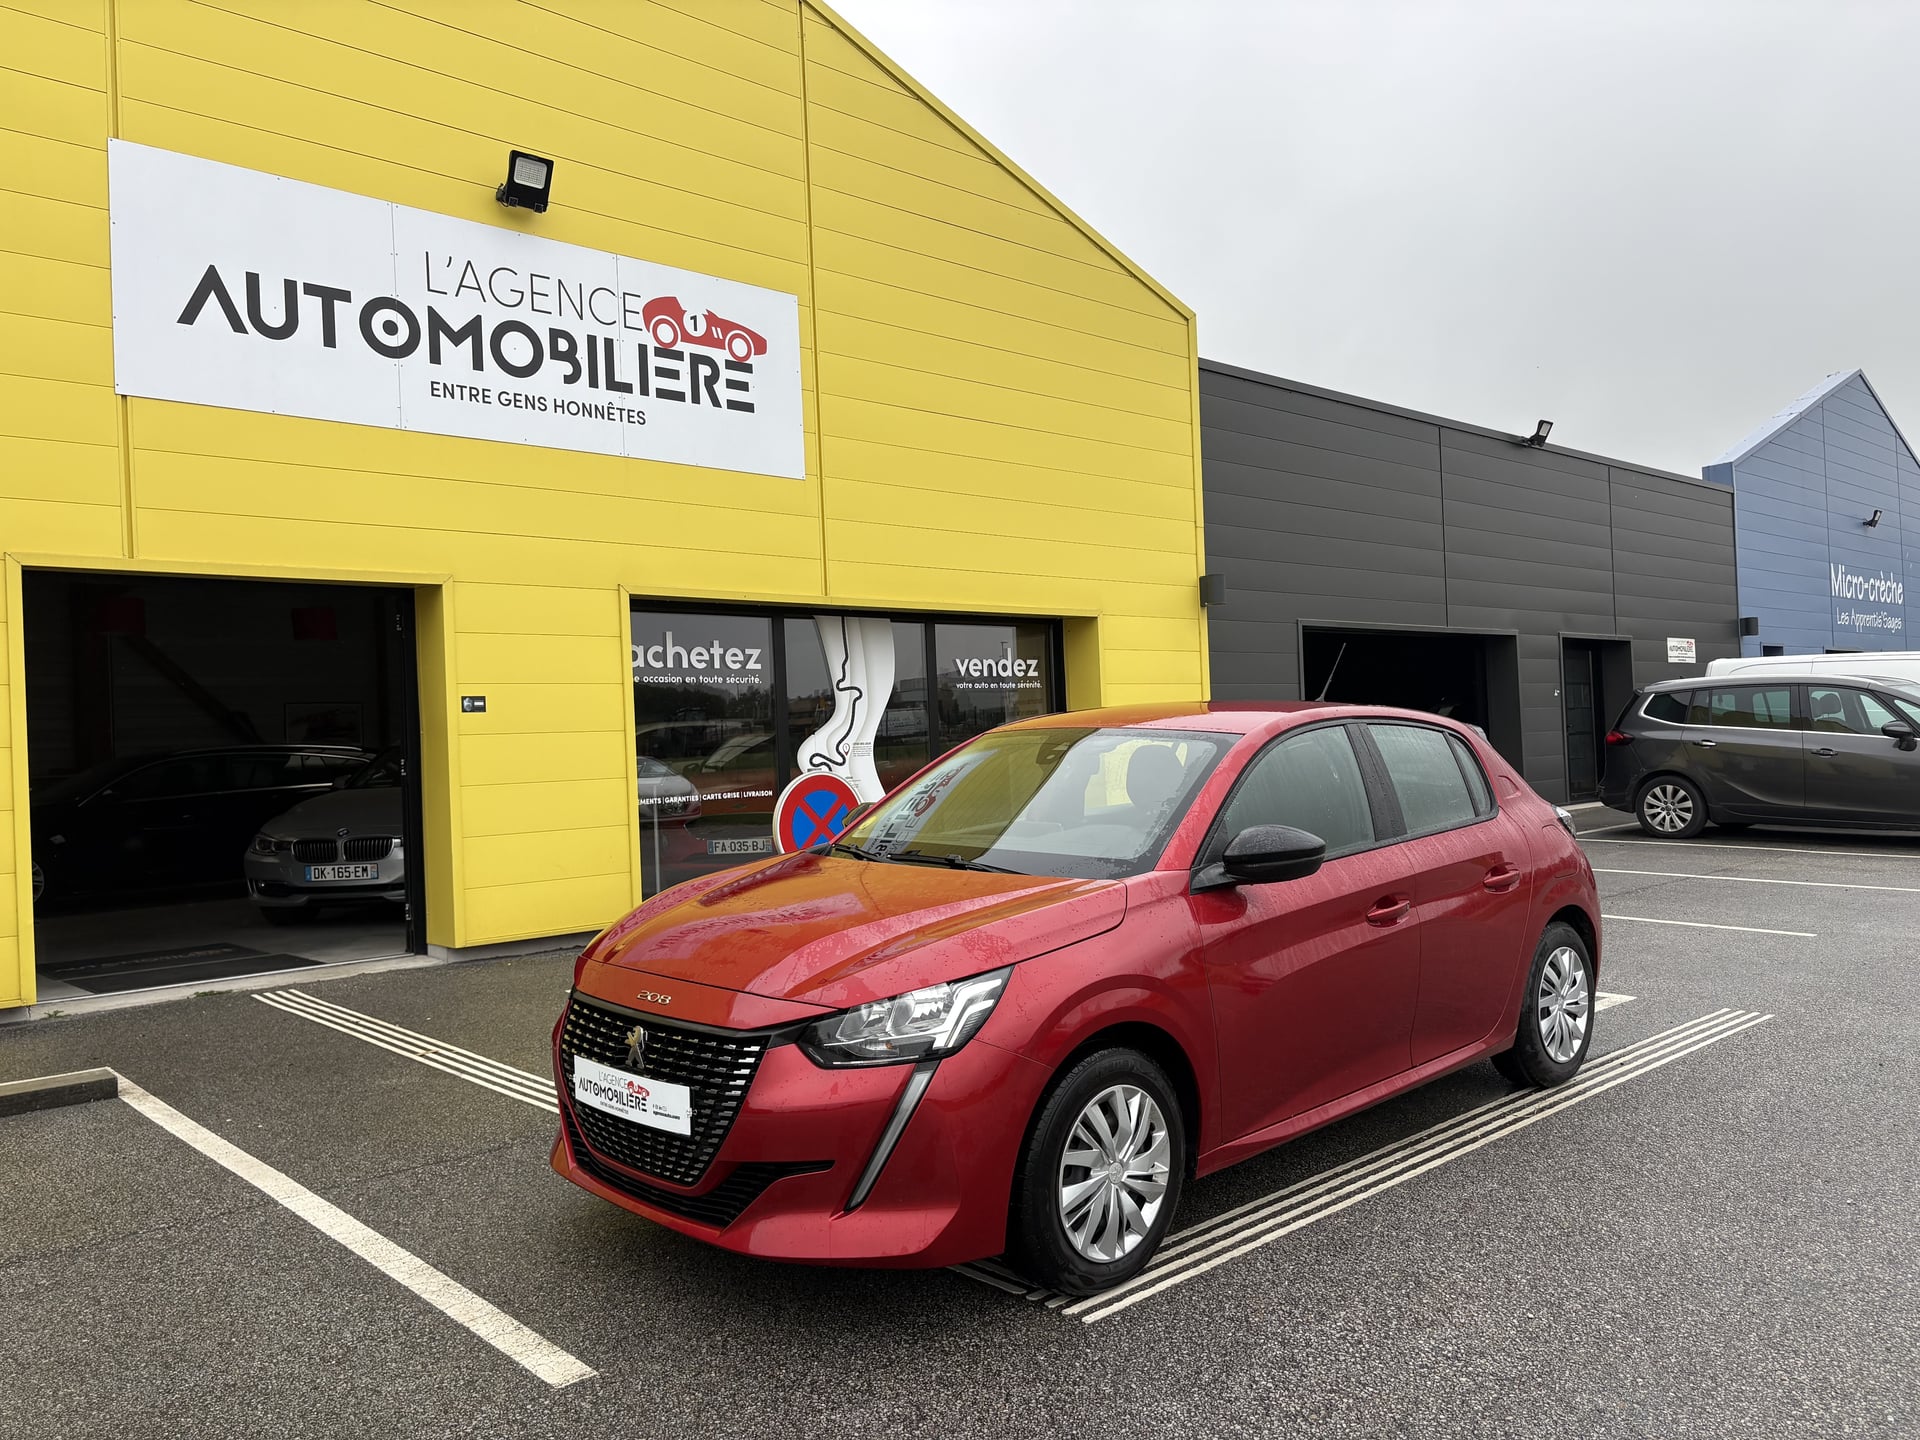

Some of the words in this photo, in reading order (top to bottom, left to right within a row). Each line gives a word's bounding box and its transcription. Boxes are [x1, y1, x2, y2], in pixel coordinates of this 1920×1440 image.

[425, 250, 643, 332] L'AGENCE
[176, 264, 755, 413] AUTOMOBILIERE
[430, 380, 492, 406] ENTRE
[497, 389, 548, 414] GENS
[553, 397, 647, 426] HONNÊTES
[1830, 562, 1904, 605] Micro-crèche
[1836, 607, 1849, 625] Les
[631, 631, 762, 670] achetez
[955, 647, 1039, 678] vendez
[643, 673, 682, 684] occasion
[685, 675, 697, 684] en
[699, 674, 723, 684] toute
[726, 673, 762, 685] sécurité.
[956, 681, 973, 689] votre
[974, 681, 989, 689] auto
[999, 681, 1016, 689] toute
[664, 794, 699, 804] GARANTIES
[702, 792, 722, 801] CARTE
[722, 791, 740, 800] GRISE
[743, 789, 773, 798] LIVRAISON
[636, 989, 672, 1005] 208
